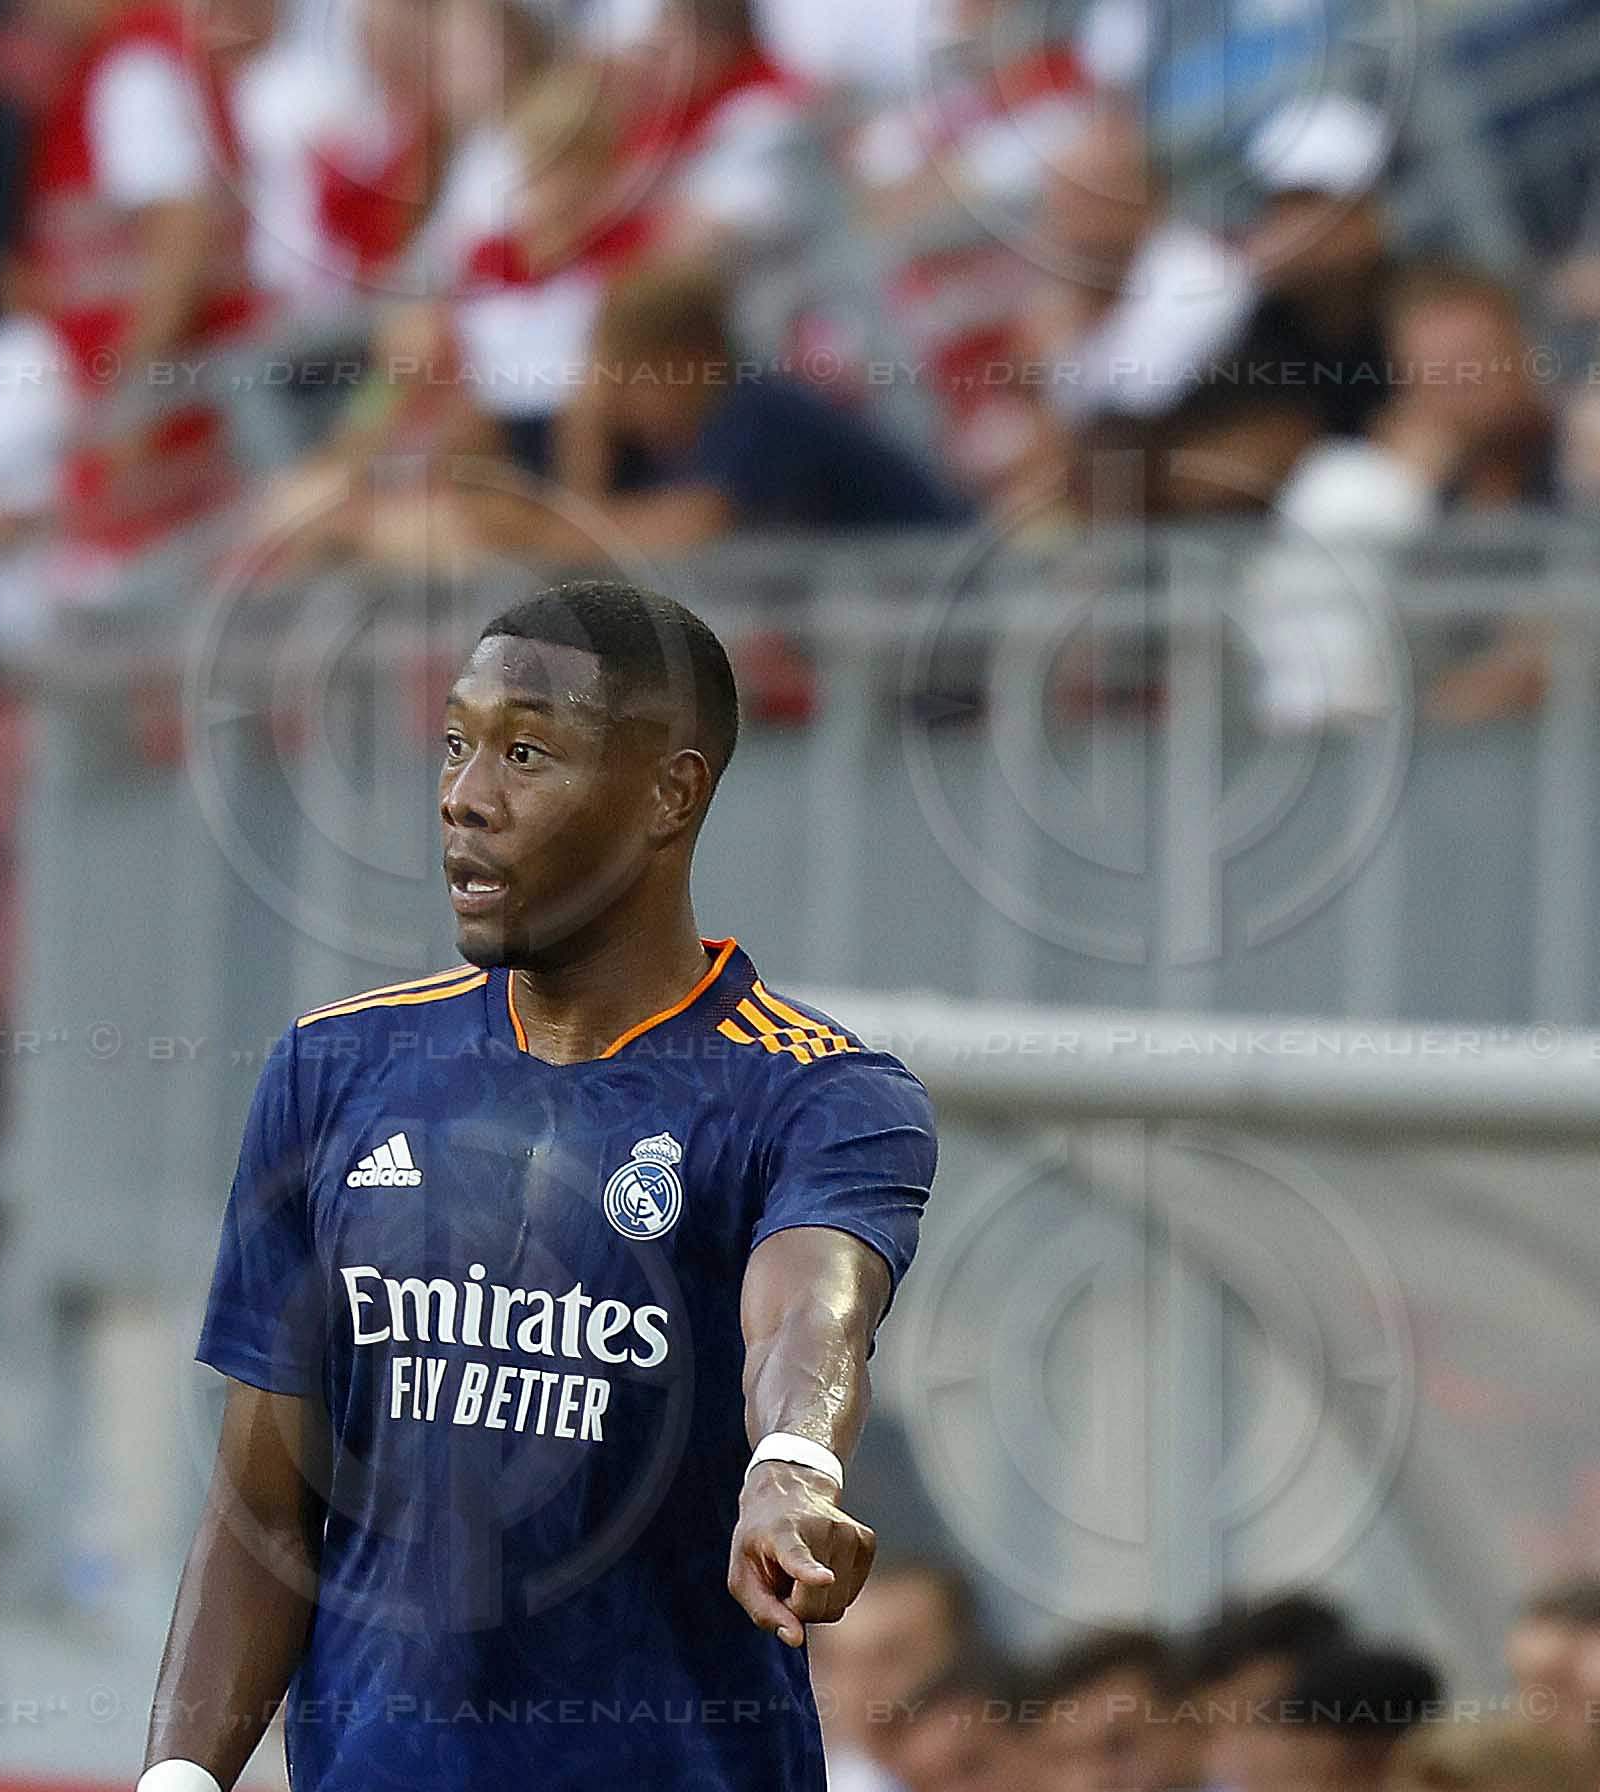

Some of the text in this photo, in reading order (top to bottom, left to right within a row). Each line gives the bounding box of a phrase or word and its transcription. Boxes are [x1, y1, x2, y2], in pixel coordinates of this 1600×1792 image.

[346, 1166, 423, 1188] adidas
[340, 1263, 668, 1368] Emirates
[390, 1356, 611, 1441] FLY BETTER
